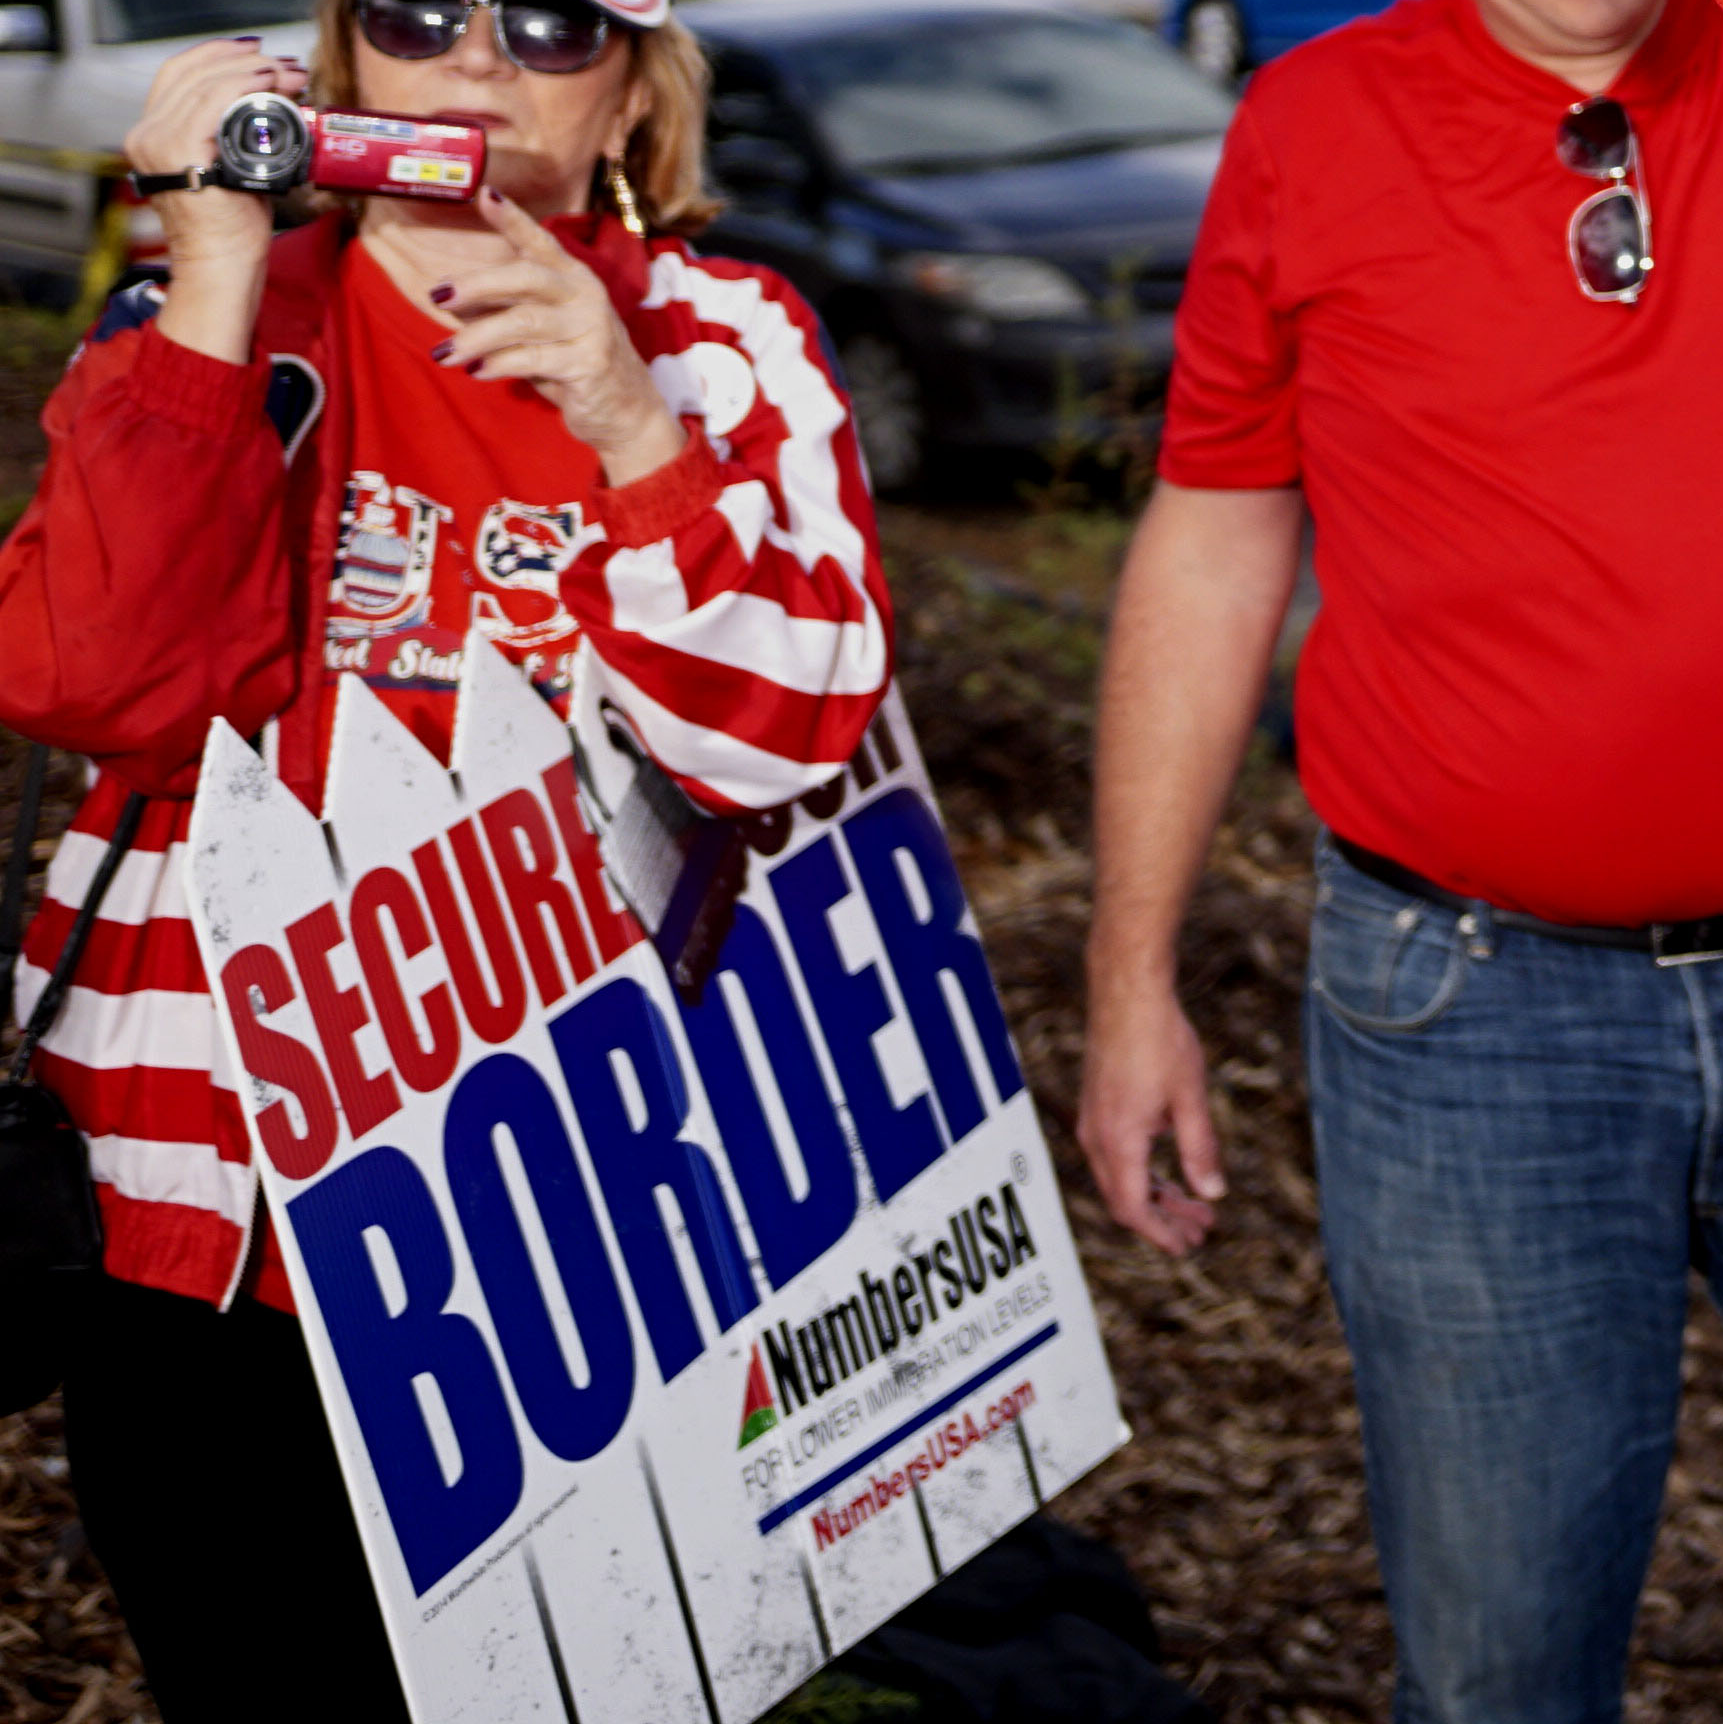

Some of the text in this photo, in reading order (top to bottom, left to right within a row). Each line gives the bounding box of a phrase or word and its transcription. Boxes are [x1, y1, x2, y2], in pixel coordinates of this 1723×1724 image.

[220, 754, 648, 1181] SECURE
[286, 786, 1025, 1598] BORDER
[741, 1273, 1053, 1498] FOR LOWER IMMIGRATION LEVELS
[810, 1379, 1038, 1552] NumbersUSA.com
